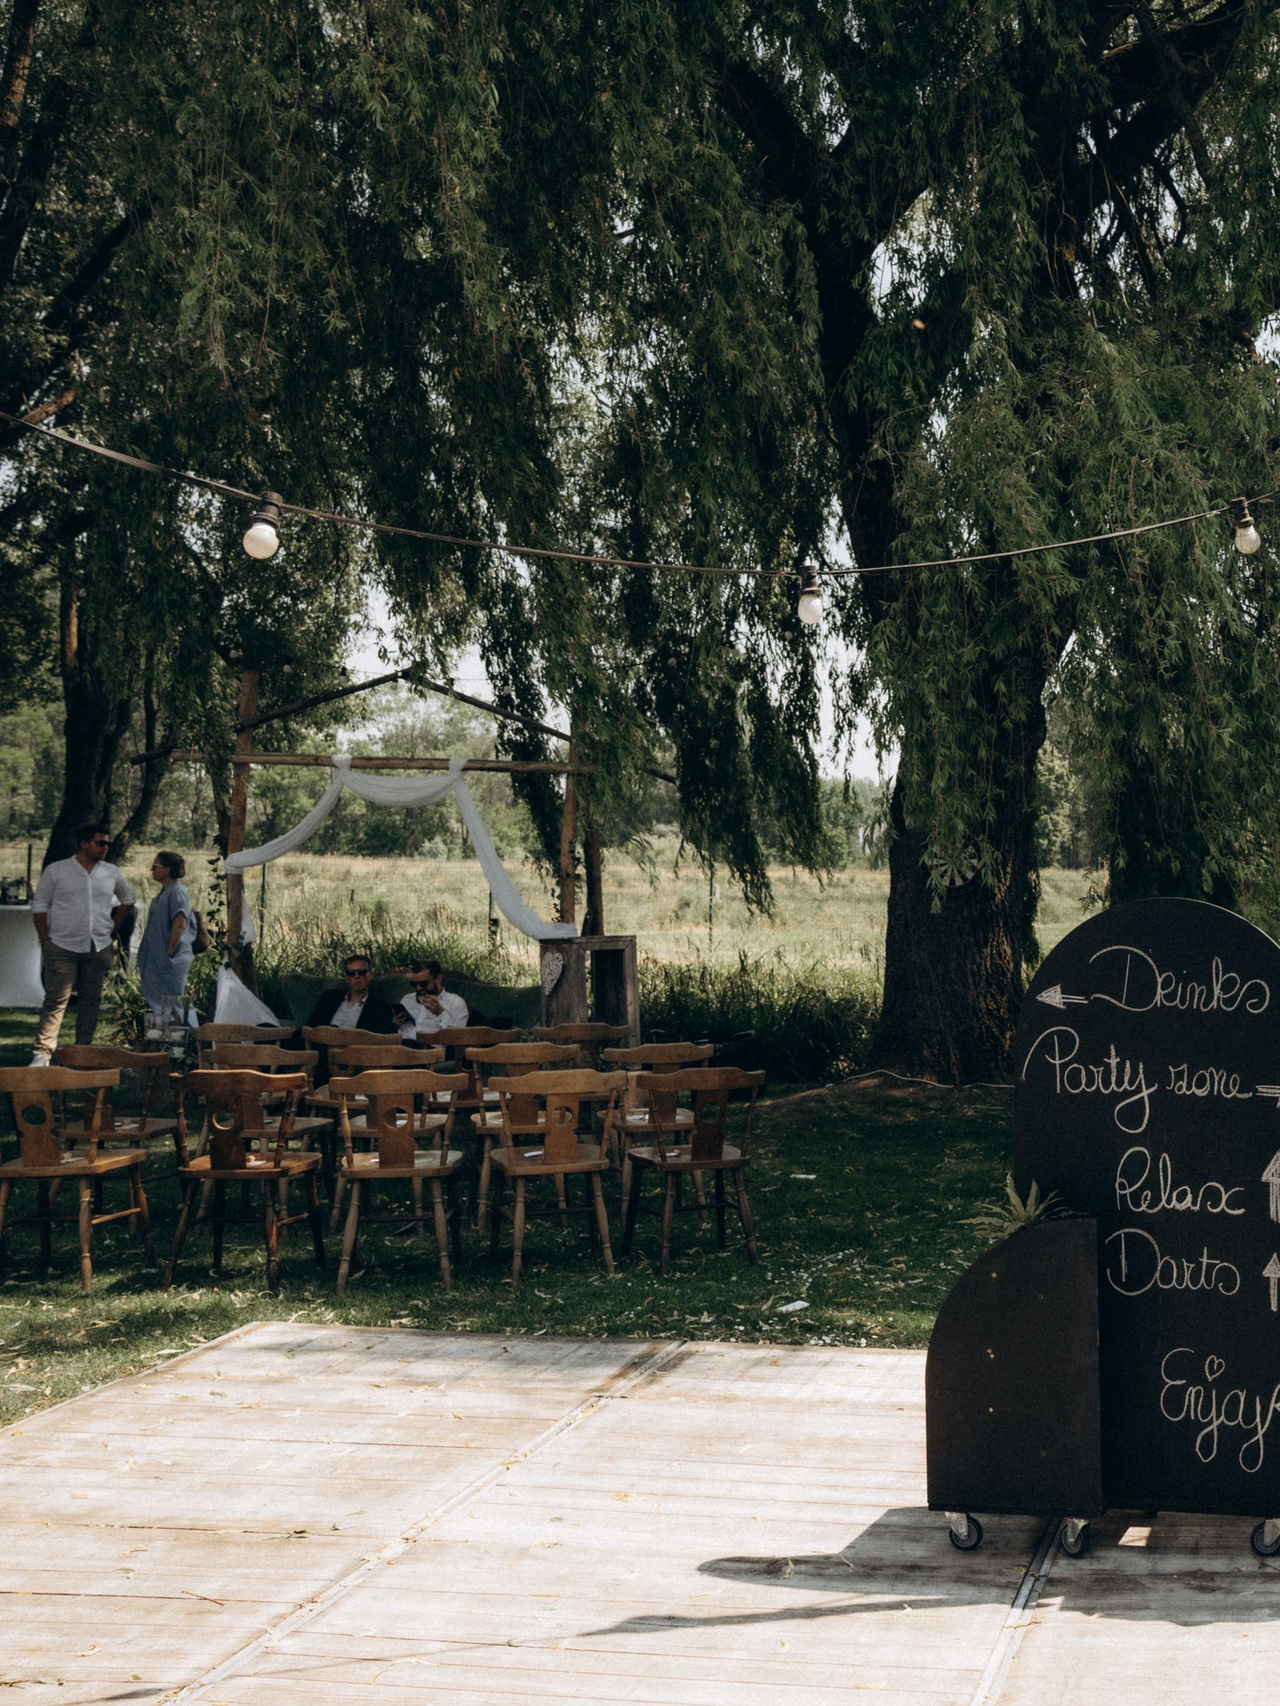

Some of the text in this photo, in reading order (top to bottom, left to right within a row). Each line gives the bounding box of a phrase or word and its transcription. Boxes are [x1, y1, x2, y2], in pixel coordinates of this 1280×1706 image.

[1089, 945, 1270, 1014] Drinks
[1022, 1026, 1252, 1133] Party zone
[1115, 1146, 1245, 1213] Relax
[1105, 1228, 1240, 1295] Darts
